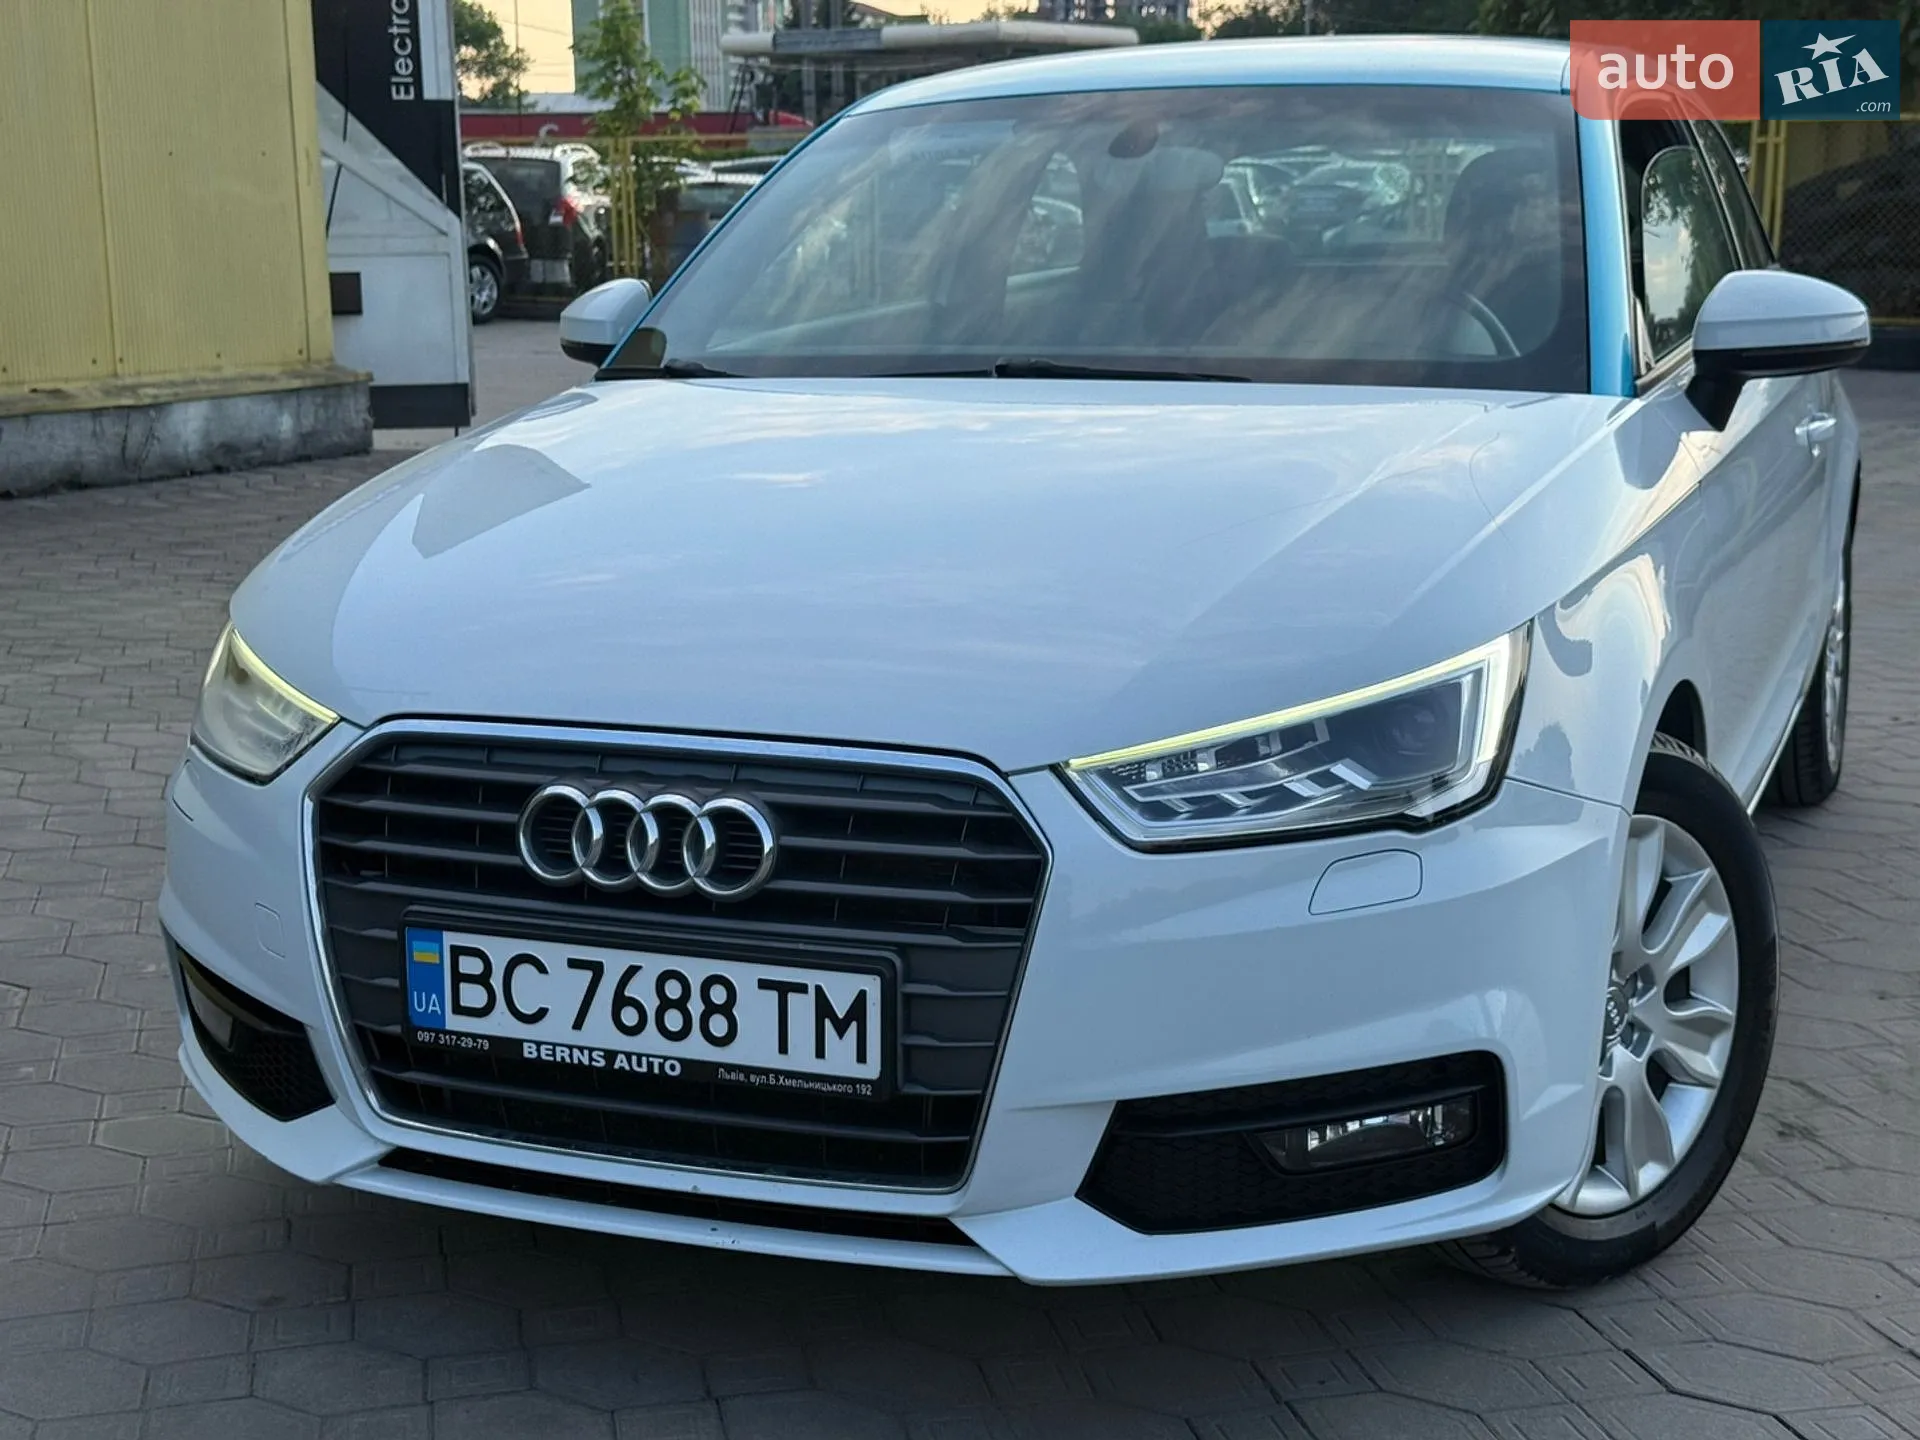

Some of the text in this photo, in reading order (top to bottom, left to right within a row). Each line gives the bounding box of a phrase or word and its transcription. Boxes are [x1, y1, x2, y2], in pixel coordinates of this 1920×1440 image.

[413, 991, 442, 1016] UA
[449, 944, 868, 1064] BC 7688 TM
[417, 1031, 490, 1051] 097 317-29-79
[524, 1042, 682, 1077] BERNS AUTO
[856, 1083, 873, 1097] 192
